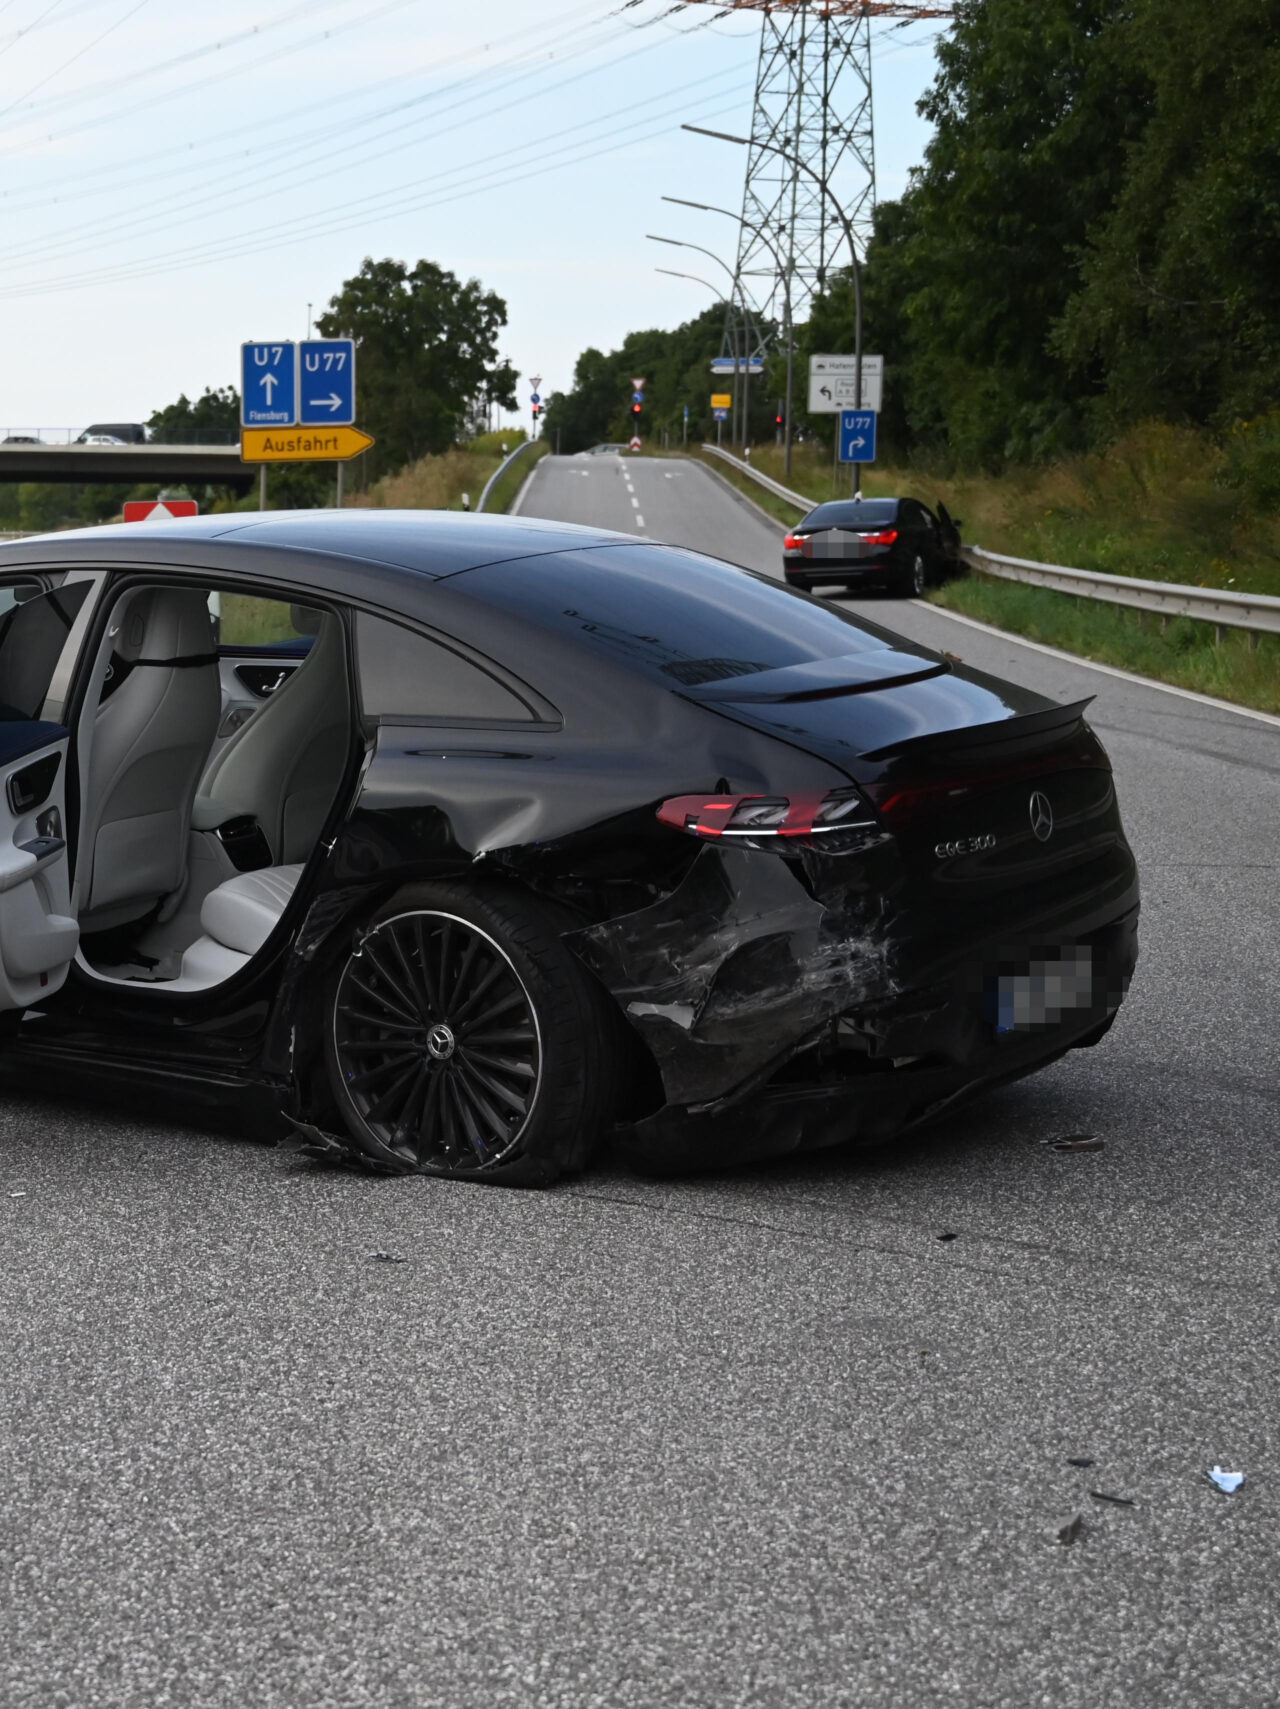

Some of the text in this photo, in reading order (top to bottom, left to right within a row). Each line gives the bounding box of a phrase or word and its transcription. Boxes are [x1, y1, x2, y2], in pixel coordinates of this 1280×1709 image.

[249, 411, 289, 422] Flensburg
[262, 435, 339, 453] Ausfahrt
[935, 840, 967, 858] EQE
